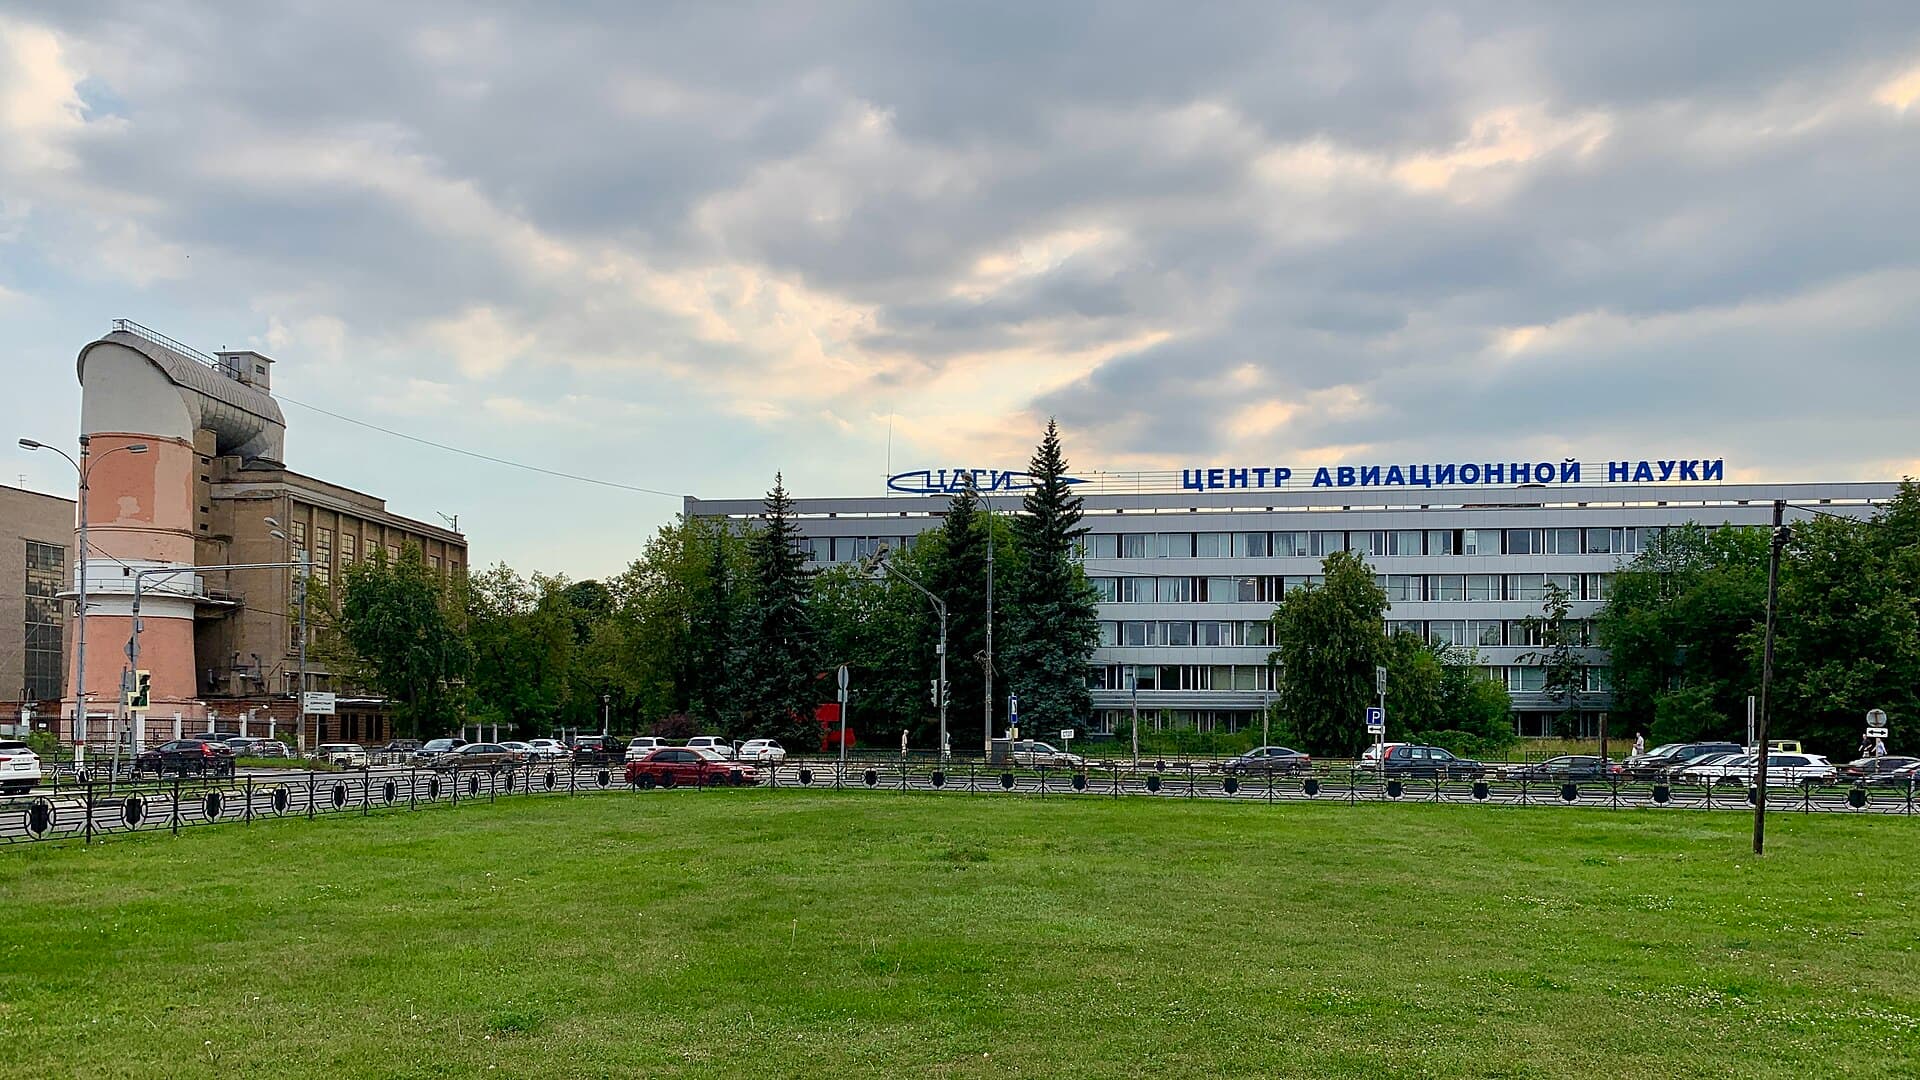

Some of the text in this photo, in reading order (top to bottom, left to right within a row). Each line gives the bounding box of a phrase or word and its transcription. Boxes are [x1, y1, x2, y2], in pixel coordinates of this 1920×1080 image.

[925, 469, 1012, 493] ЦАГИ
[1183, 458, 1723, 491] ЦЕНТР АВИАЦИОННОЙ НАУКИ
[1372, 711, 1381, 724] P
